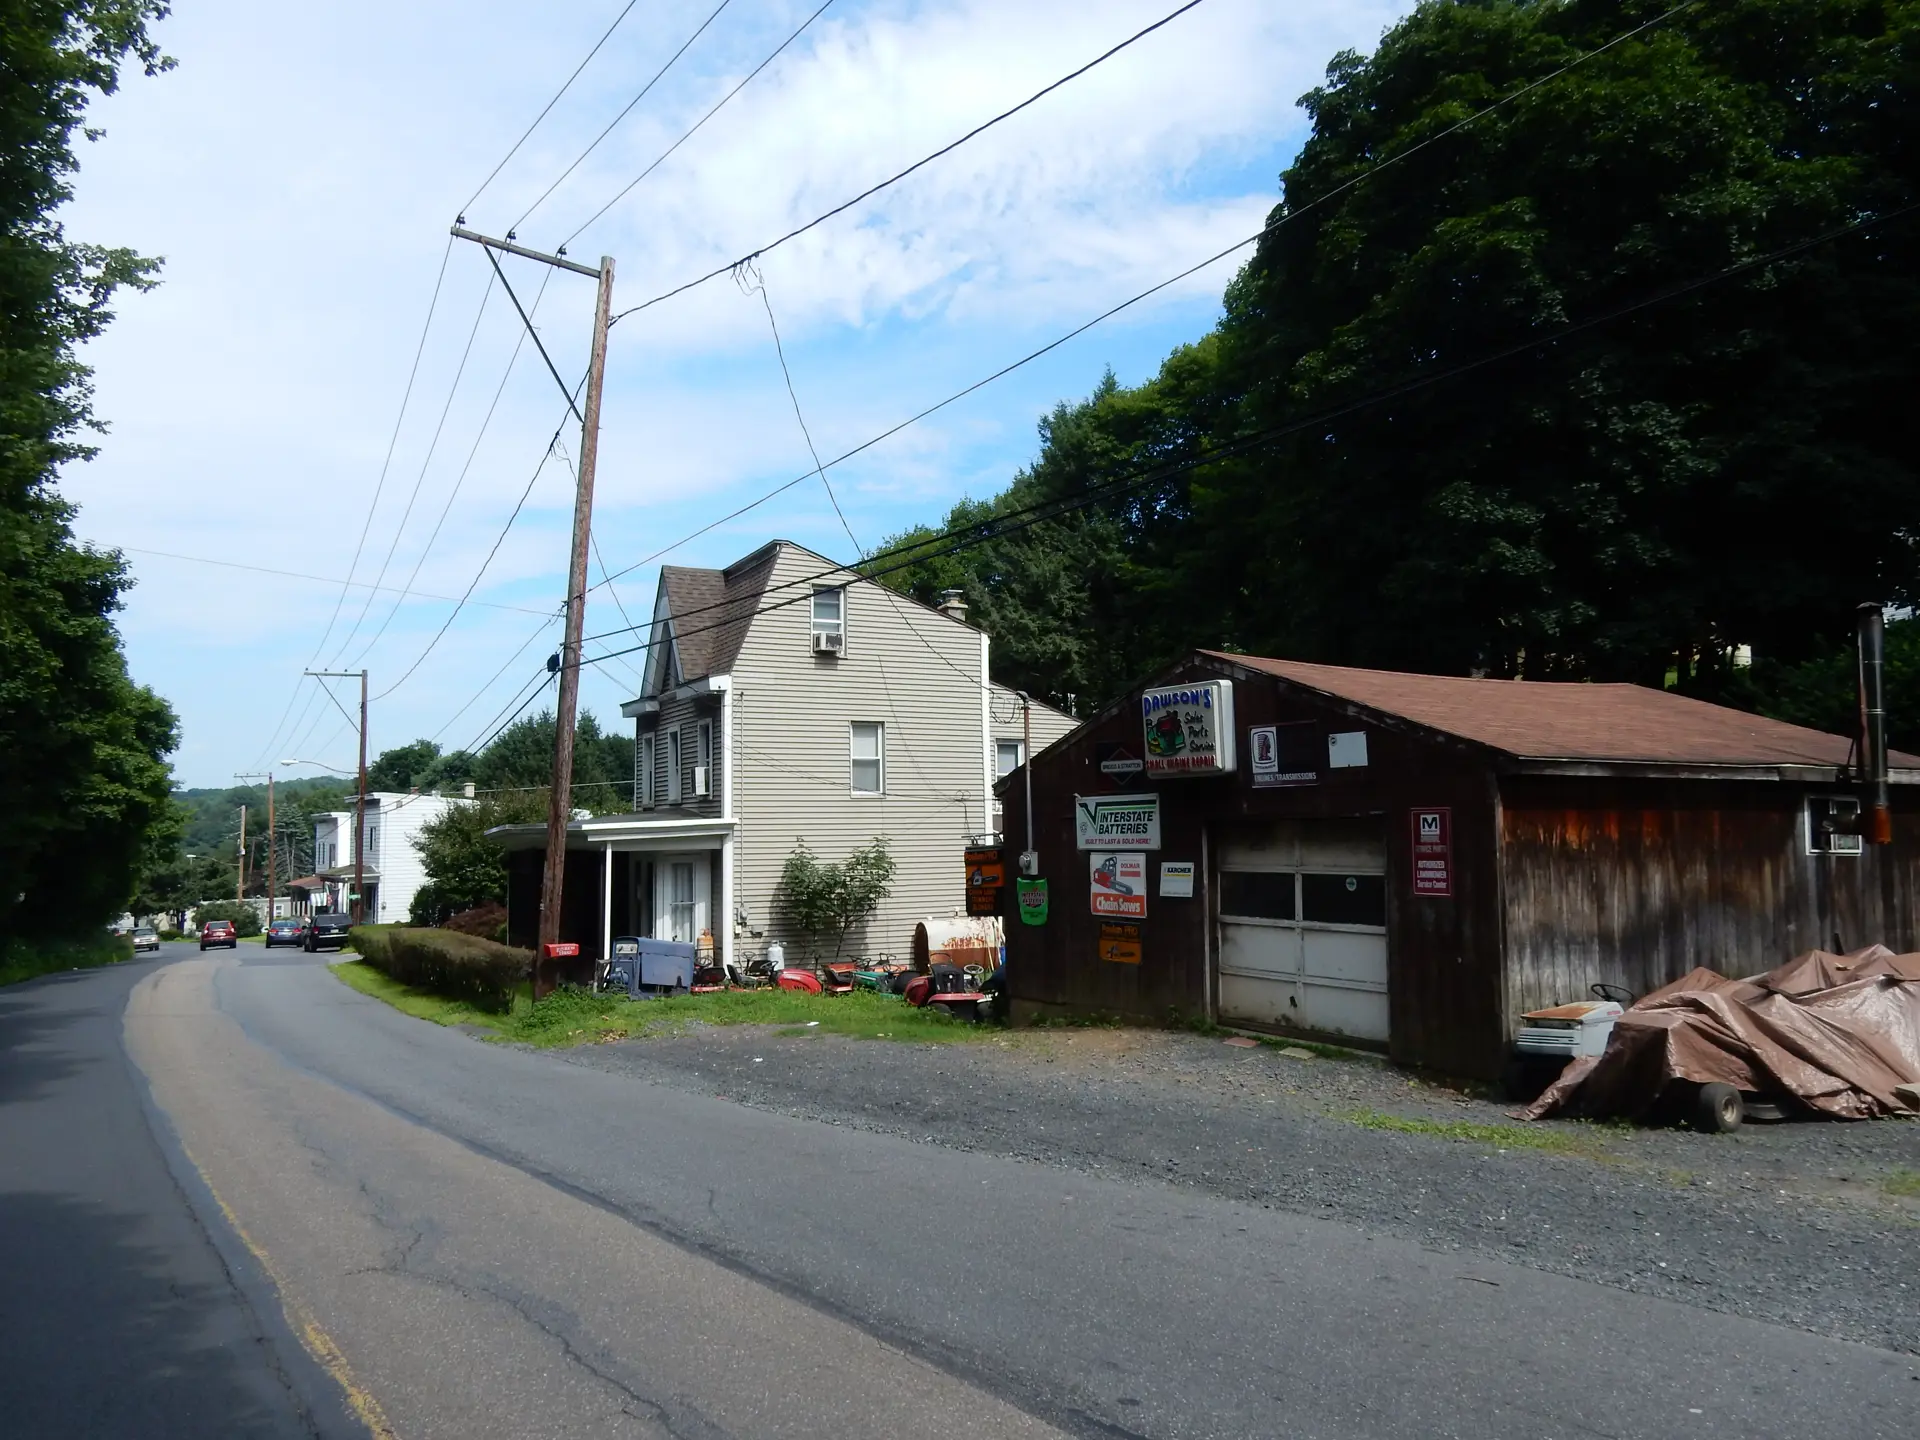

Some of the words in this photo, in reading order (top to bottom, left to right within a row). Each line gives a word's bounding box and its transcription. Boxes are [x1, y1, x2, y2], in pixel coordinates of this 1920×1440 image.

[1143, 688, 1211, 717] DAWSON'S
[1184, 711, 1203, 724] Sales
[1188, 725, 1208, 739] Parts
[1190, 740, 1215, 753] Service
[1146, 759, 1165, 770] SMALL
[1166, 757, 1190, 769] ENGINE
[1192, 755, 1216, 768] REPAIR
[1100, 811, 1154, 823] INTERSTATE
[1421, 816, 1438, 829] M
[1099, 823, 1149, 835] BATTERIES
[1097, 896, 1119, 910] Chain
[1120, 898, 1140, 912] Saws
